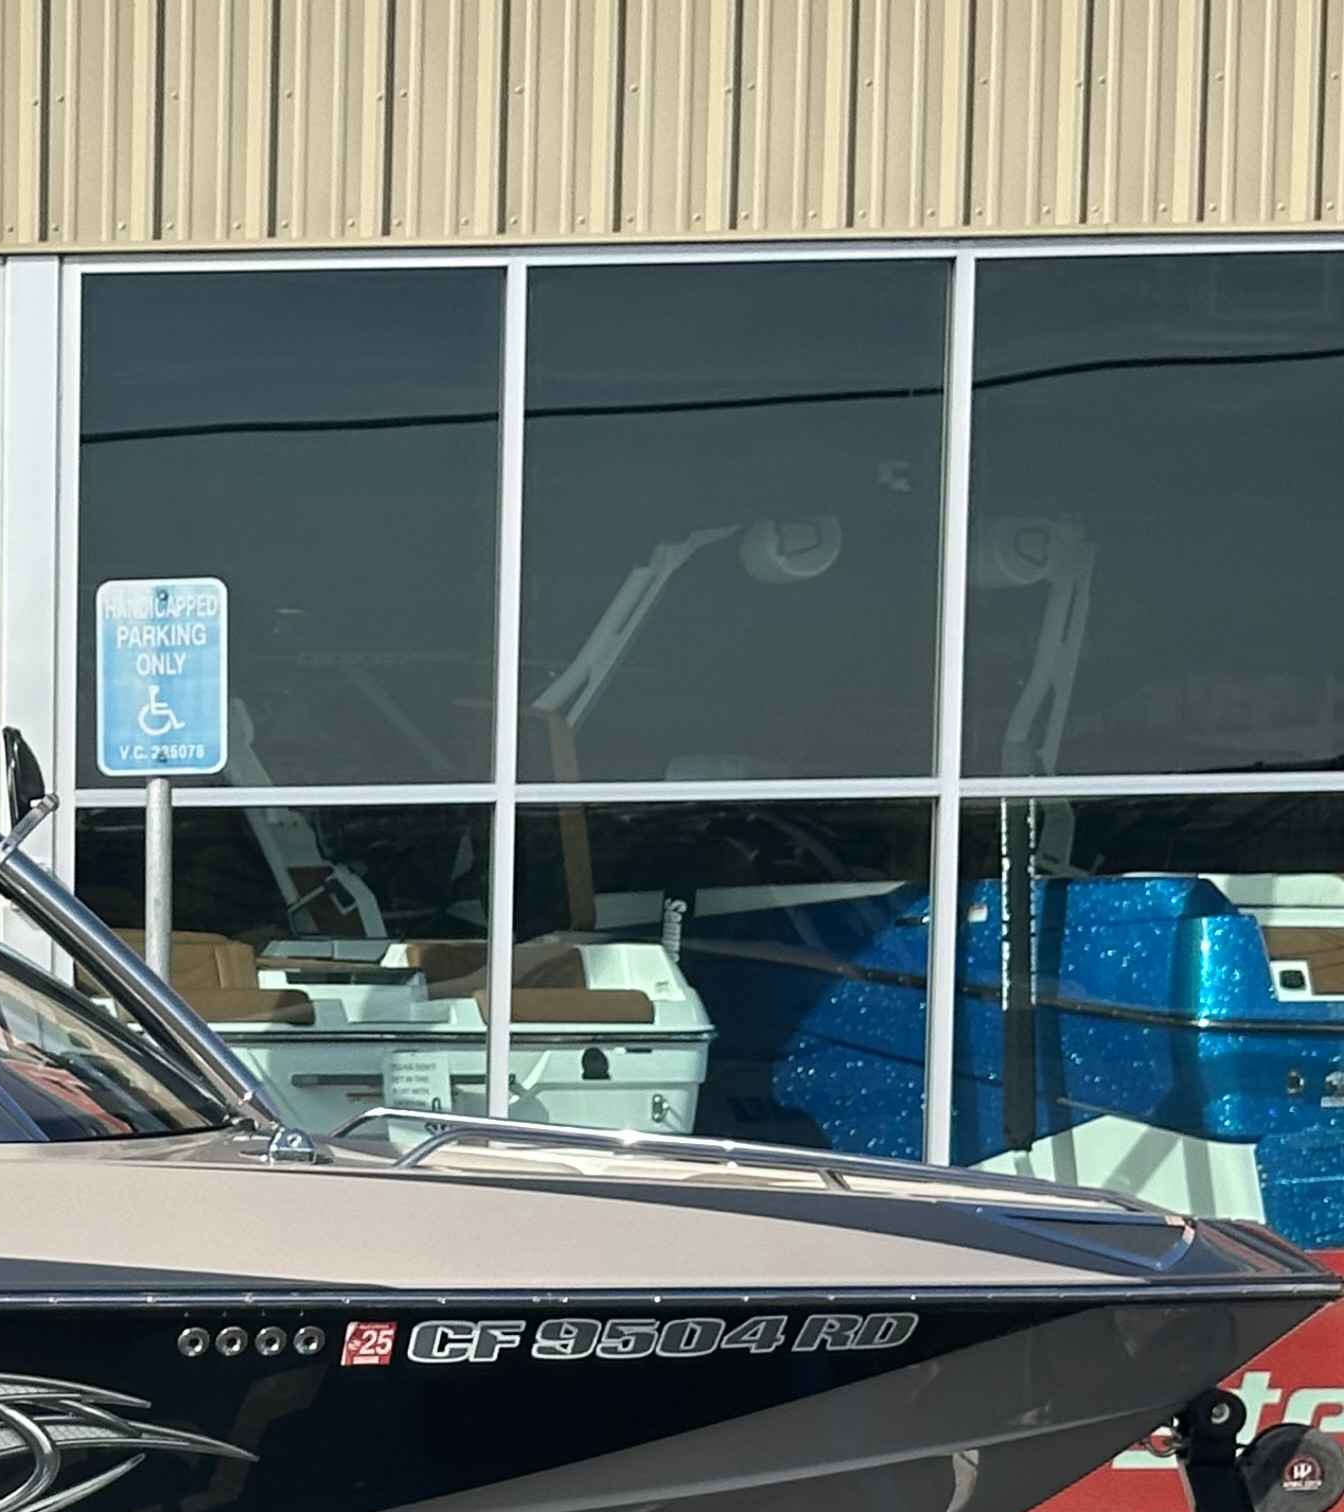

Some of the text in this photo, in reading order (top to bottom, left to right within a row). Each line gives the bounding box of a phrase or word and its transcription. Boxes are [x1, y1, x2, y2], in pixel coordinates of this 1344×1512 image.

[117, 624, 207, 648] PARKING
[136, 653, 187, 675] ONLY
[359, 1329, 395, 1355] 25
[407, 1311, 919, 1363] CF 9504 RD
